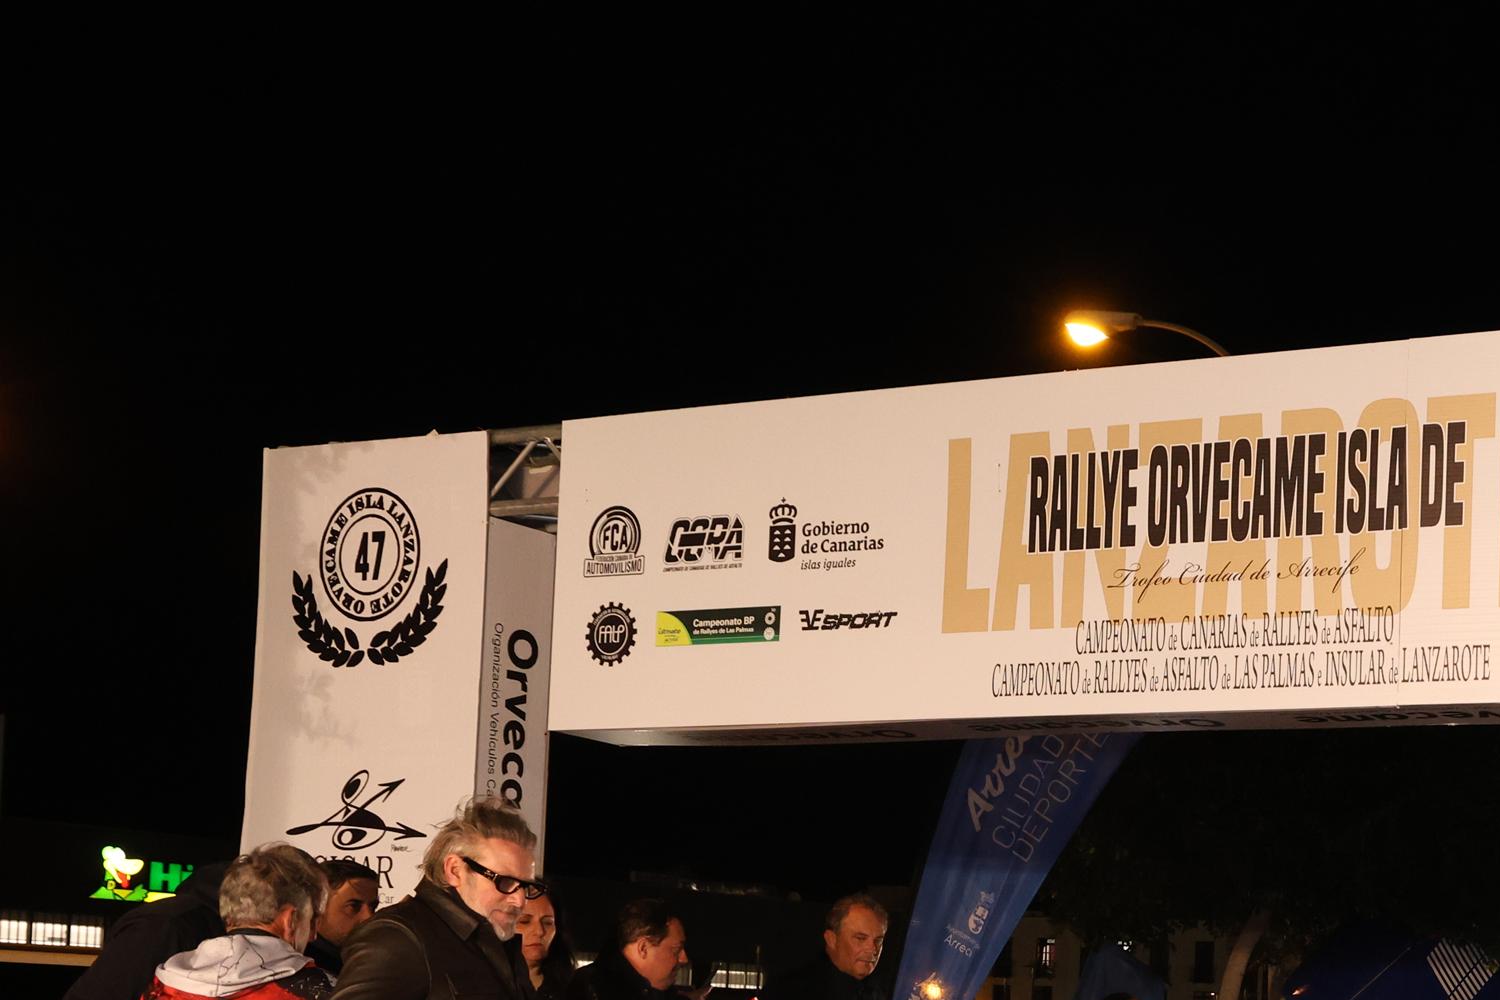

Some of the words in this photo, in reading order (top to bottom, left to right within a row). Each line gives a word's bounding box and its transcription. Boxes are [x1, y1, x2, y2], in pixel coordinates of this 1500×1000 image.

[1028, 449, 1138, 553] RALLYE
[1148, 434, 1324, 547] ORVECAME
[1335, 427, 1407, 533] ISLA
[1421, 421, 1466, 527] DE
[325, 513, 365, 614] ORVECAME
[346, 494, 385, 517] ISLA
[370, 500, 415, 614] LANZAROTE
[603, 524, 628, 551] FCA
[801, 540, 818, 554] de
[821, 536, 884, 553] Canarias
[802, 521, 869, 537] Gobierno
[354, 530, 386, 581] 47
[586, 558, 642, 575] AUTOMOVILISMO
[801, 560, 821, 570] islas
[823, 557, 856, 571] iguales
[1107, 559, 1171, 604] Trofeo
[1178, 560, 1253, 585] Ciudad
[1249, 559, 1271, 581] de
[1276, 546, 1367, 594] Arrecife
[692, 618, 742, 628] Campeonato
[743, 616, 755, 625] BP
[1076, 616, 1166, 655] CAMPEONATO
[1169, 624, 1178, 651] de
[1180, 611, 1248, 651] CANARIAS
[1250, 620, 1260, 648] de
[1262, 609, 1319, 647] RALLYES
[1321, 618, 1331, 644] de
[1333, 604, 1394, 644] ASFALTO
[491, 622, 504, 708] Organización
[992, 660, 1080, 697] CAMPEONATO
[1082, 669, 1091, 694] de
[1093, 657, 1148, 694] RALLYES
[1150, 667, 1159, 692] de
[1161, 655, 1219, 692] ASFALTO
[1222, 664, 1231, 689] de
[1233, 653, 1259, 690] LAS
[1261, 651, 1315, 689] PALMAS
[1317, 671, 1322, 687] e
[1324, 649, 1386, 687] INSULAR
[1388, 657, 1398, 685] de
[1401, 644, 1491, 683] LANZAROTE
[966, 716, 1225, 737] Orvecame
[992, 735, 1066, 850] CIUDAD
